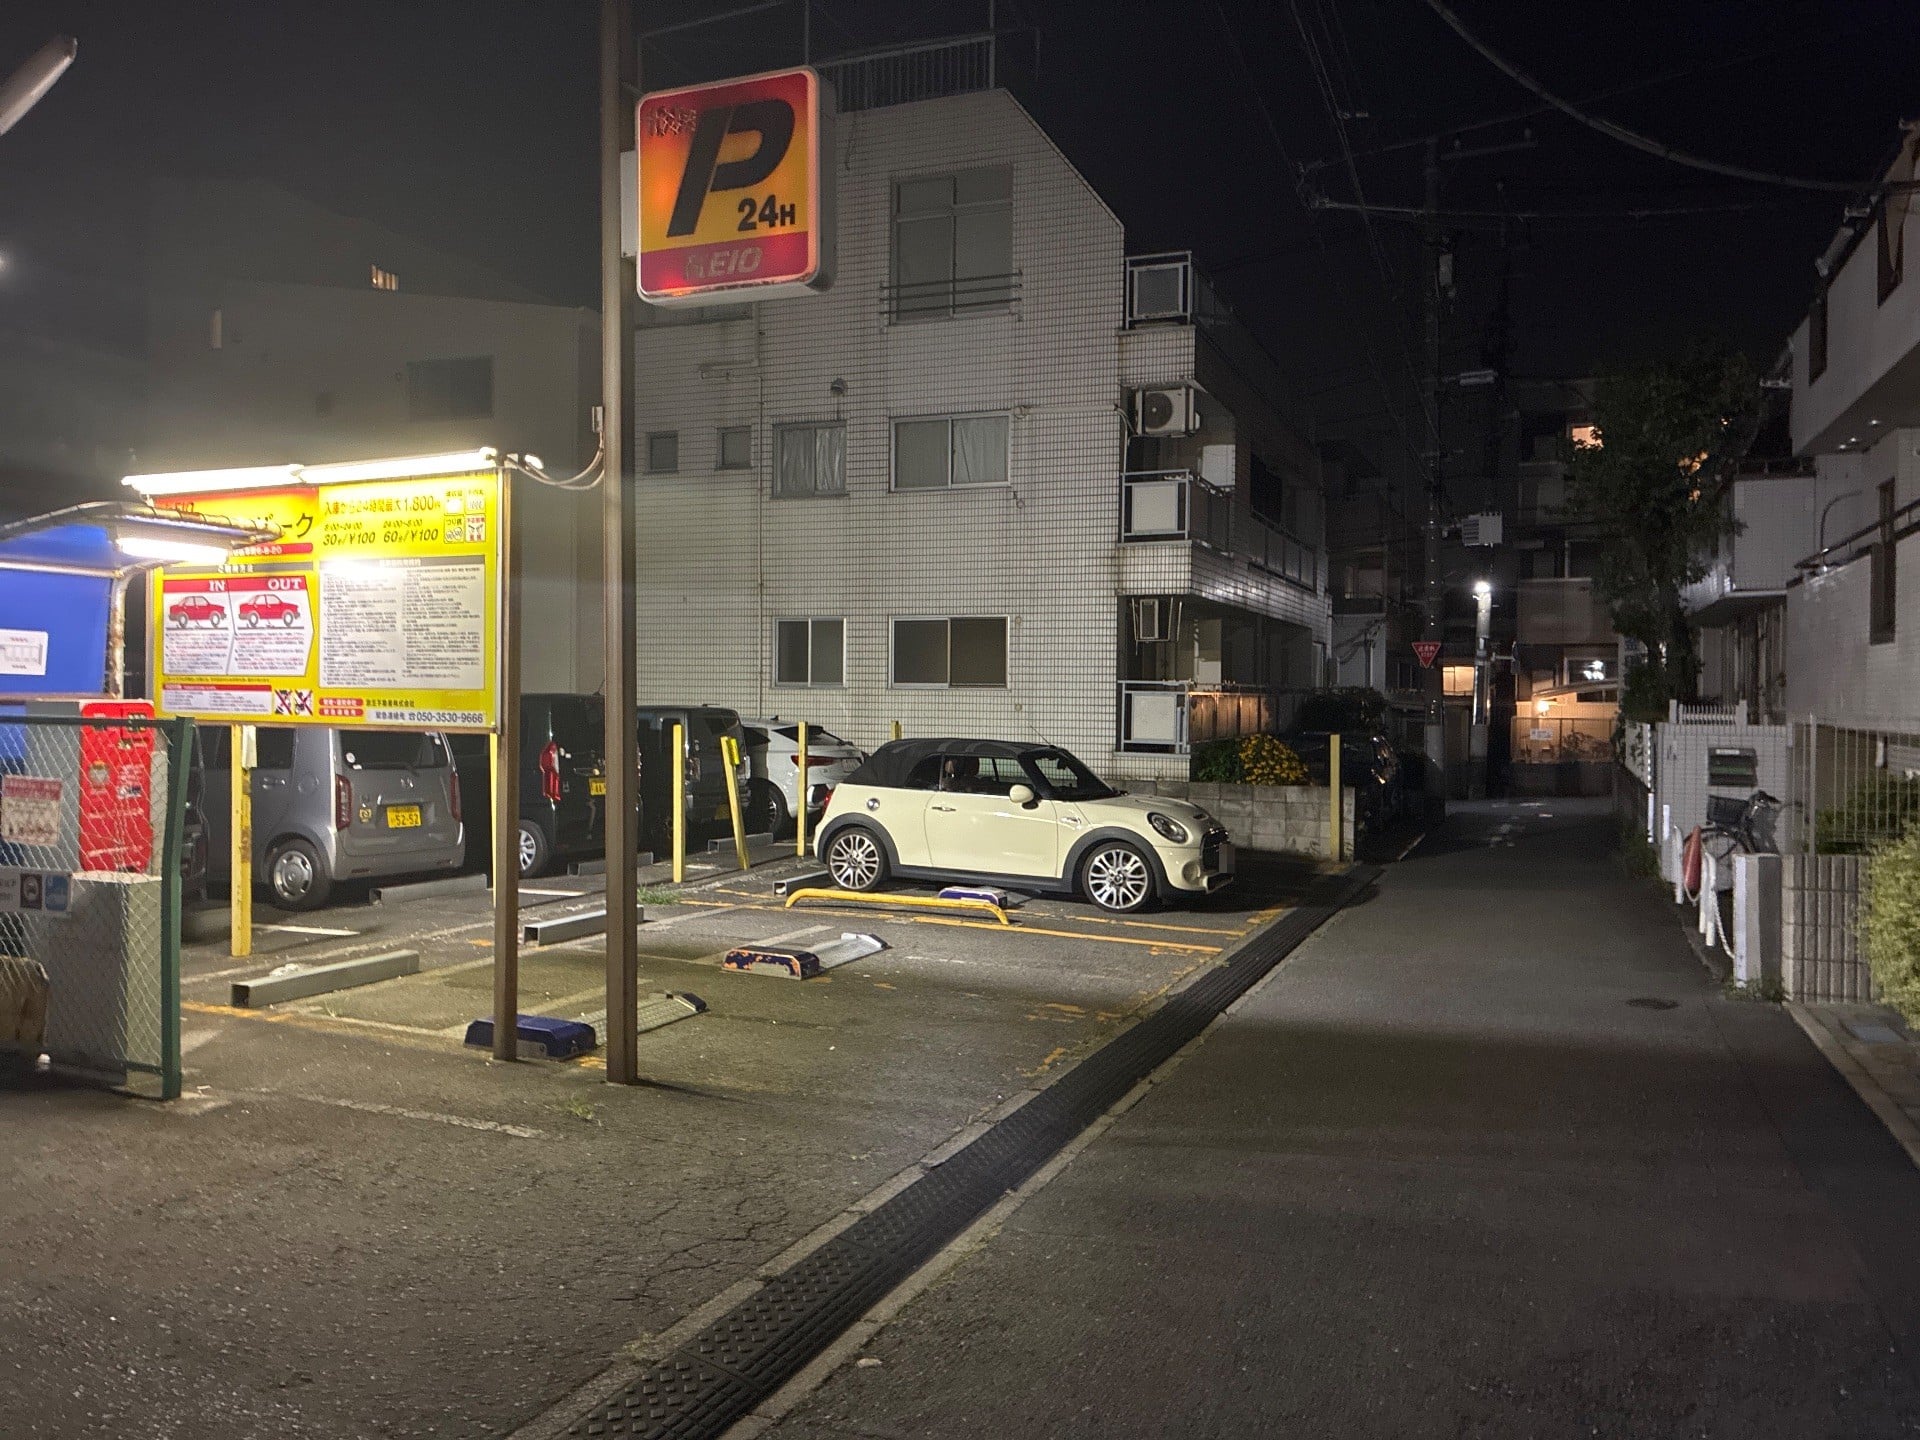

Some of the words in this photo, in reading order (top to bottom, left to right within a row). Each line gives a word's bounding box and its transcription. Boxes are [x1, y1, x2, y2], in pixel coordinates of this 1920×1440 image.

[667, 99, 795, 238] P
[737, 194, 796, 232] 24H
[208, 579, 226, 592] IN
[267, 578, 302, 590] OUT
[416, 712, 484, 724] 050-3530-9666
